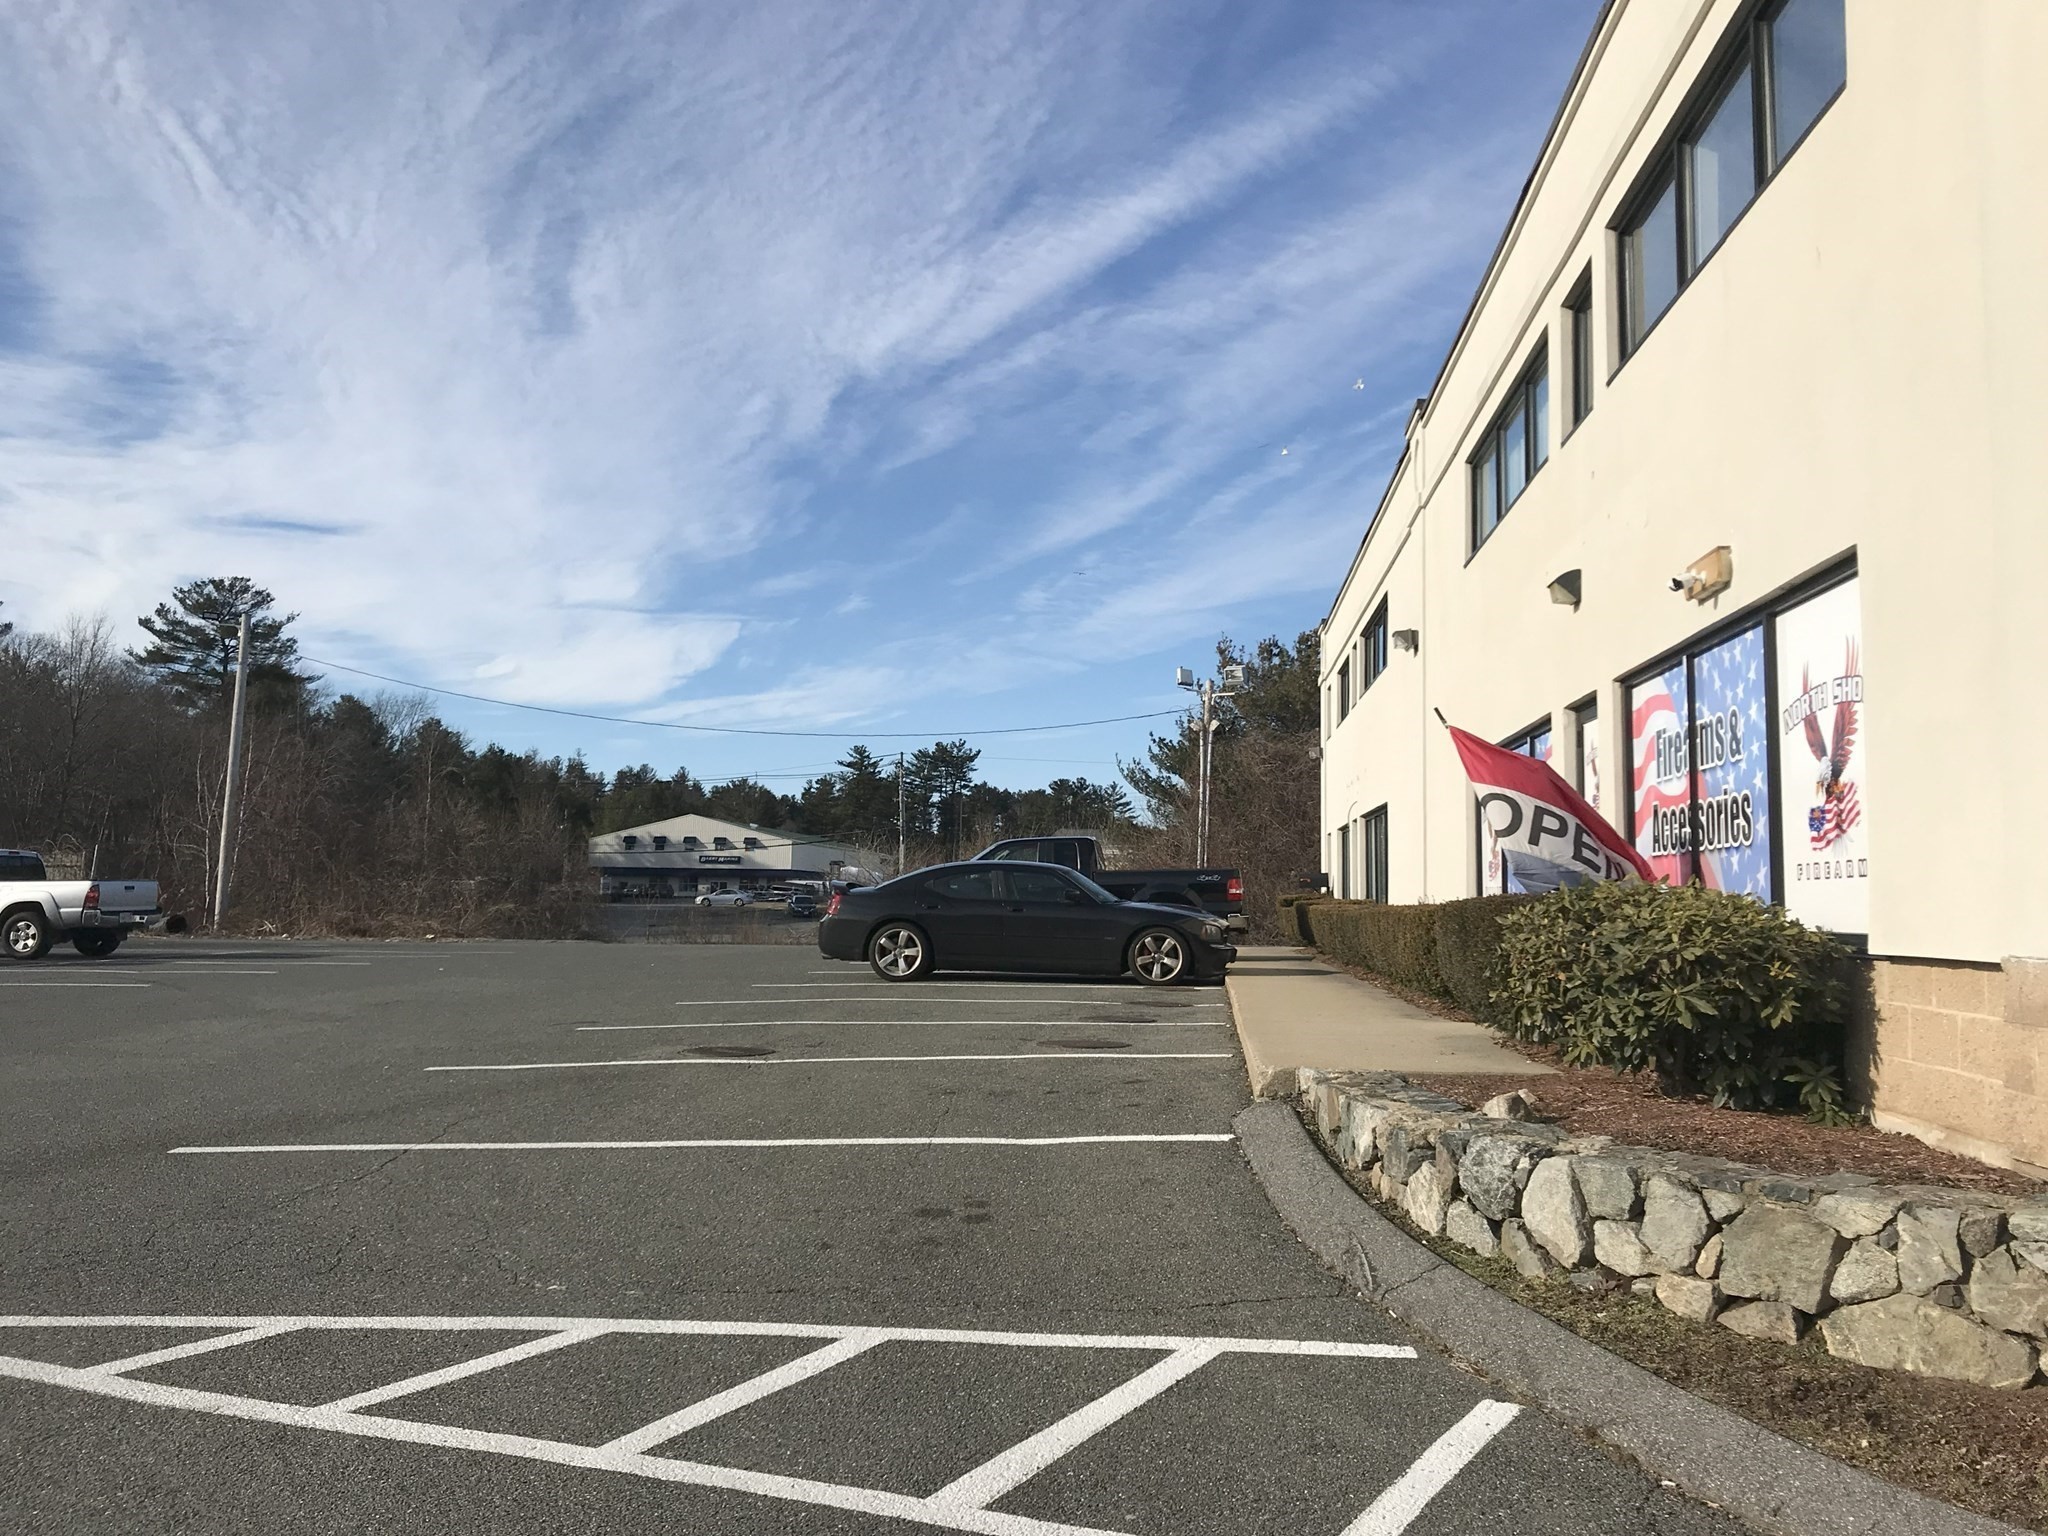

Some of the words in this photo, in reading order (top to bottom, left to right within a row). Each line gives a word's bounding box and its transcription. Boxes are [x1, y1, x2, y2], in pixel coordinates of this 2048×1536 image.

[1655, 712, 1727, 782] Fireams
[1727, 705, 1744, 763] &
[1783, 682, 1828, 735] NORTH
[1480, 792, 1626, 882] OPEN
